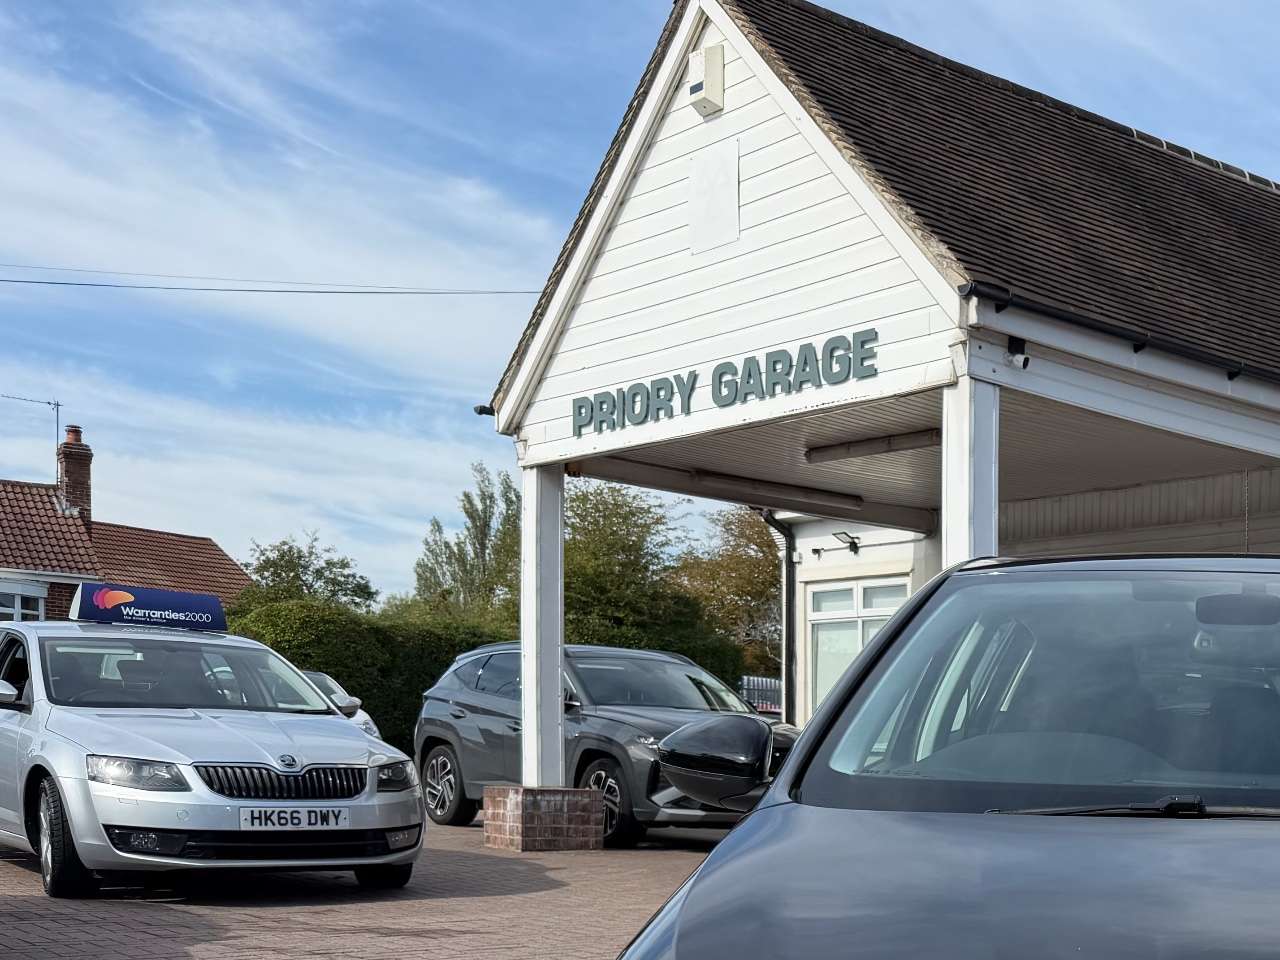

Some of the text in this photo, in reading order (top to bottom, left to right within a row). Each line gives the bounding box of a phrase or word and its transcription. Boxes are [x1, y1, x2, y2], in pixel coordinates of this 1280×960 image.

[572, 327, 879, 438] PRIORY GARAGE
[120, 605, 212, 623] Warranties2000
[250, 810, 341, 826] HK66 DWY
